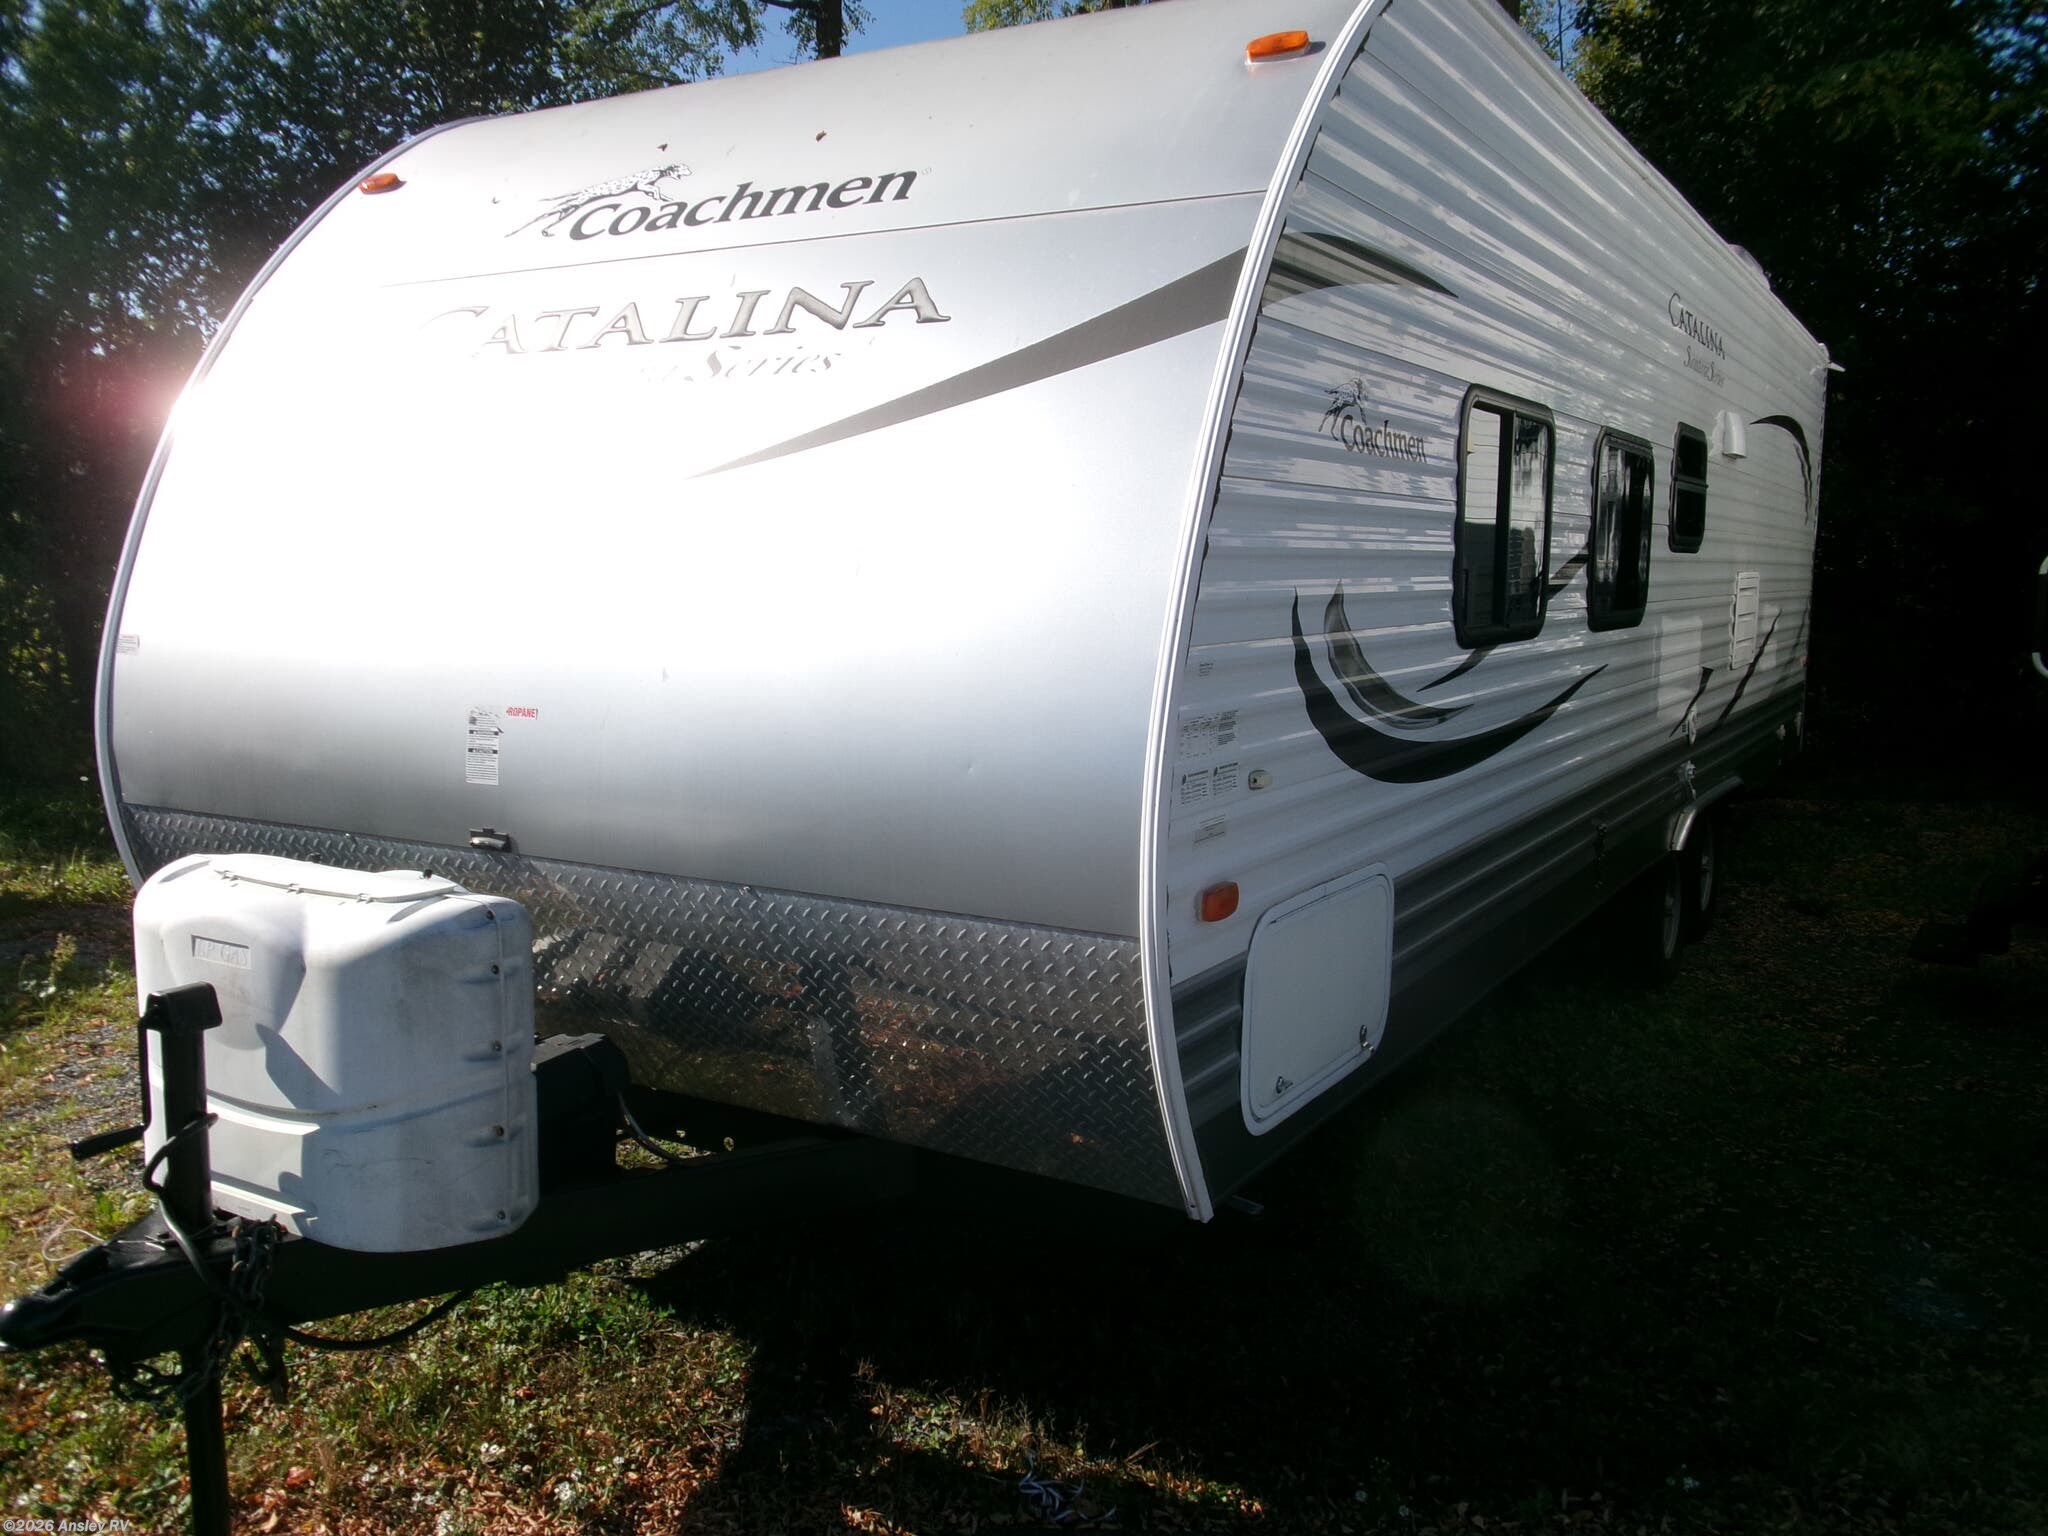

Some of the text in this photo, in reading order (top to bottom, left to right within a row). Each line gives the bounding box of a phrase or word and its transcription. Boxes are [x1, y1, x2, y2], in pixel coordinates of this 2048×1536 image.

[569, 170, 918, 241] Coachmen
[1668, 292, 1726, 361] CATALINA
[1341, 414, 1427, 463] Coachmen
